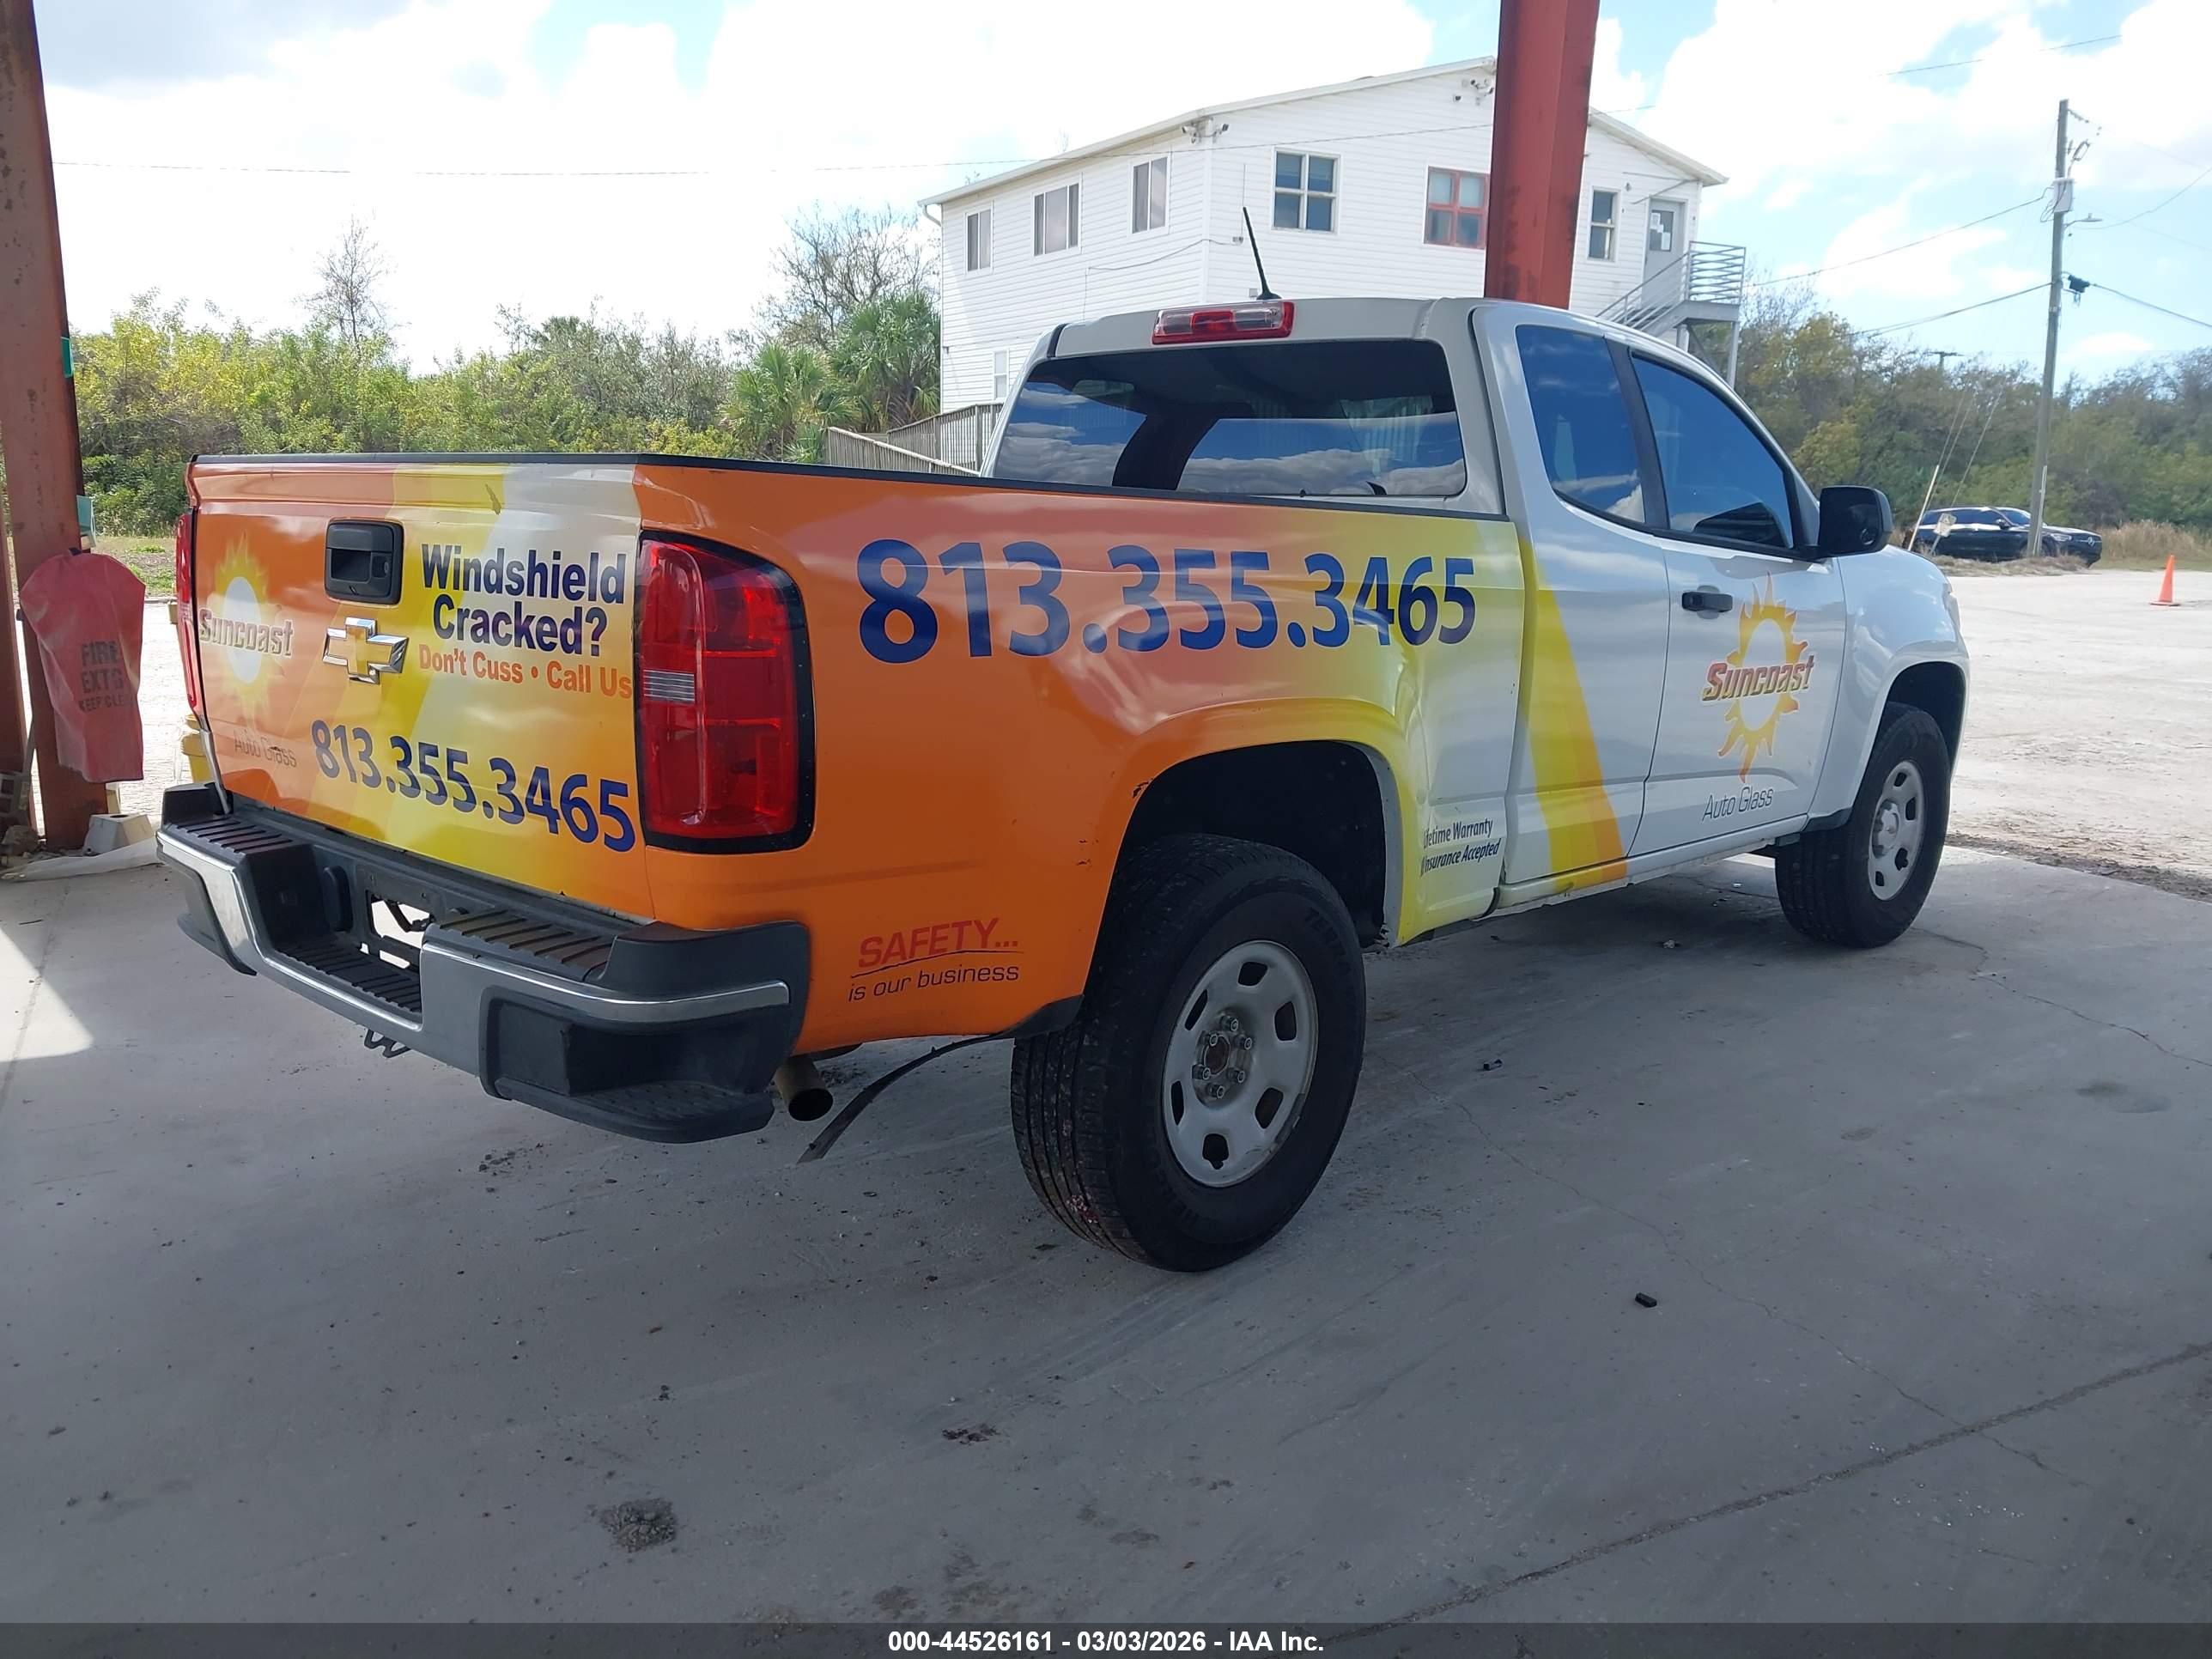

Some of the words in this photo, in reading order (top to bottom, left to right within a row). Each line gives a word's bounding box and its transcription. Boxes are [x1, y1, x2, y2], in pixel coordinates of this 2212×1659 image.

[422, 543, 627, 605] Windshield
[433, 593, 608, 657] Cracked?
[855, 538, 1476, 665] 813.355.3465
[198, 607, 295, 657] Suncoast
[419, 644, 467, 676] Don't
[472, 652, 524, 684] Cuss
[546, 659, 592, 694] Call
[600, 666, 634, 700] Us
[1701, 654, 1814, 702] Suncoast
[310, 720, 637, 854] 813.355.3465
[1701, 794, 1736, 822] Auto
[1738, 786, 1774, 813] Glass
[1452, 817, 1493, 841] Warranty
[1461, 837, 1502, 864] Accepted
[859, 917, 1019, 969] SAFETY...
[848, 983, 866, 1002] is
[873, 976, 912, 997] our
[917, 963, 1019, 989] business
